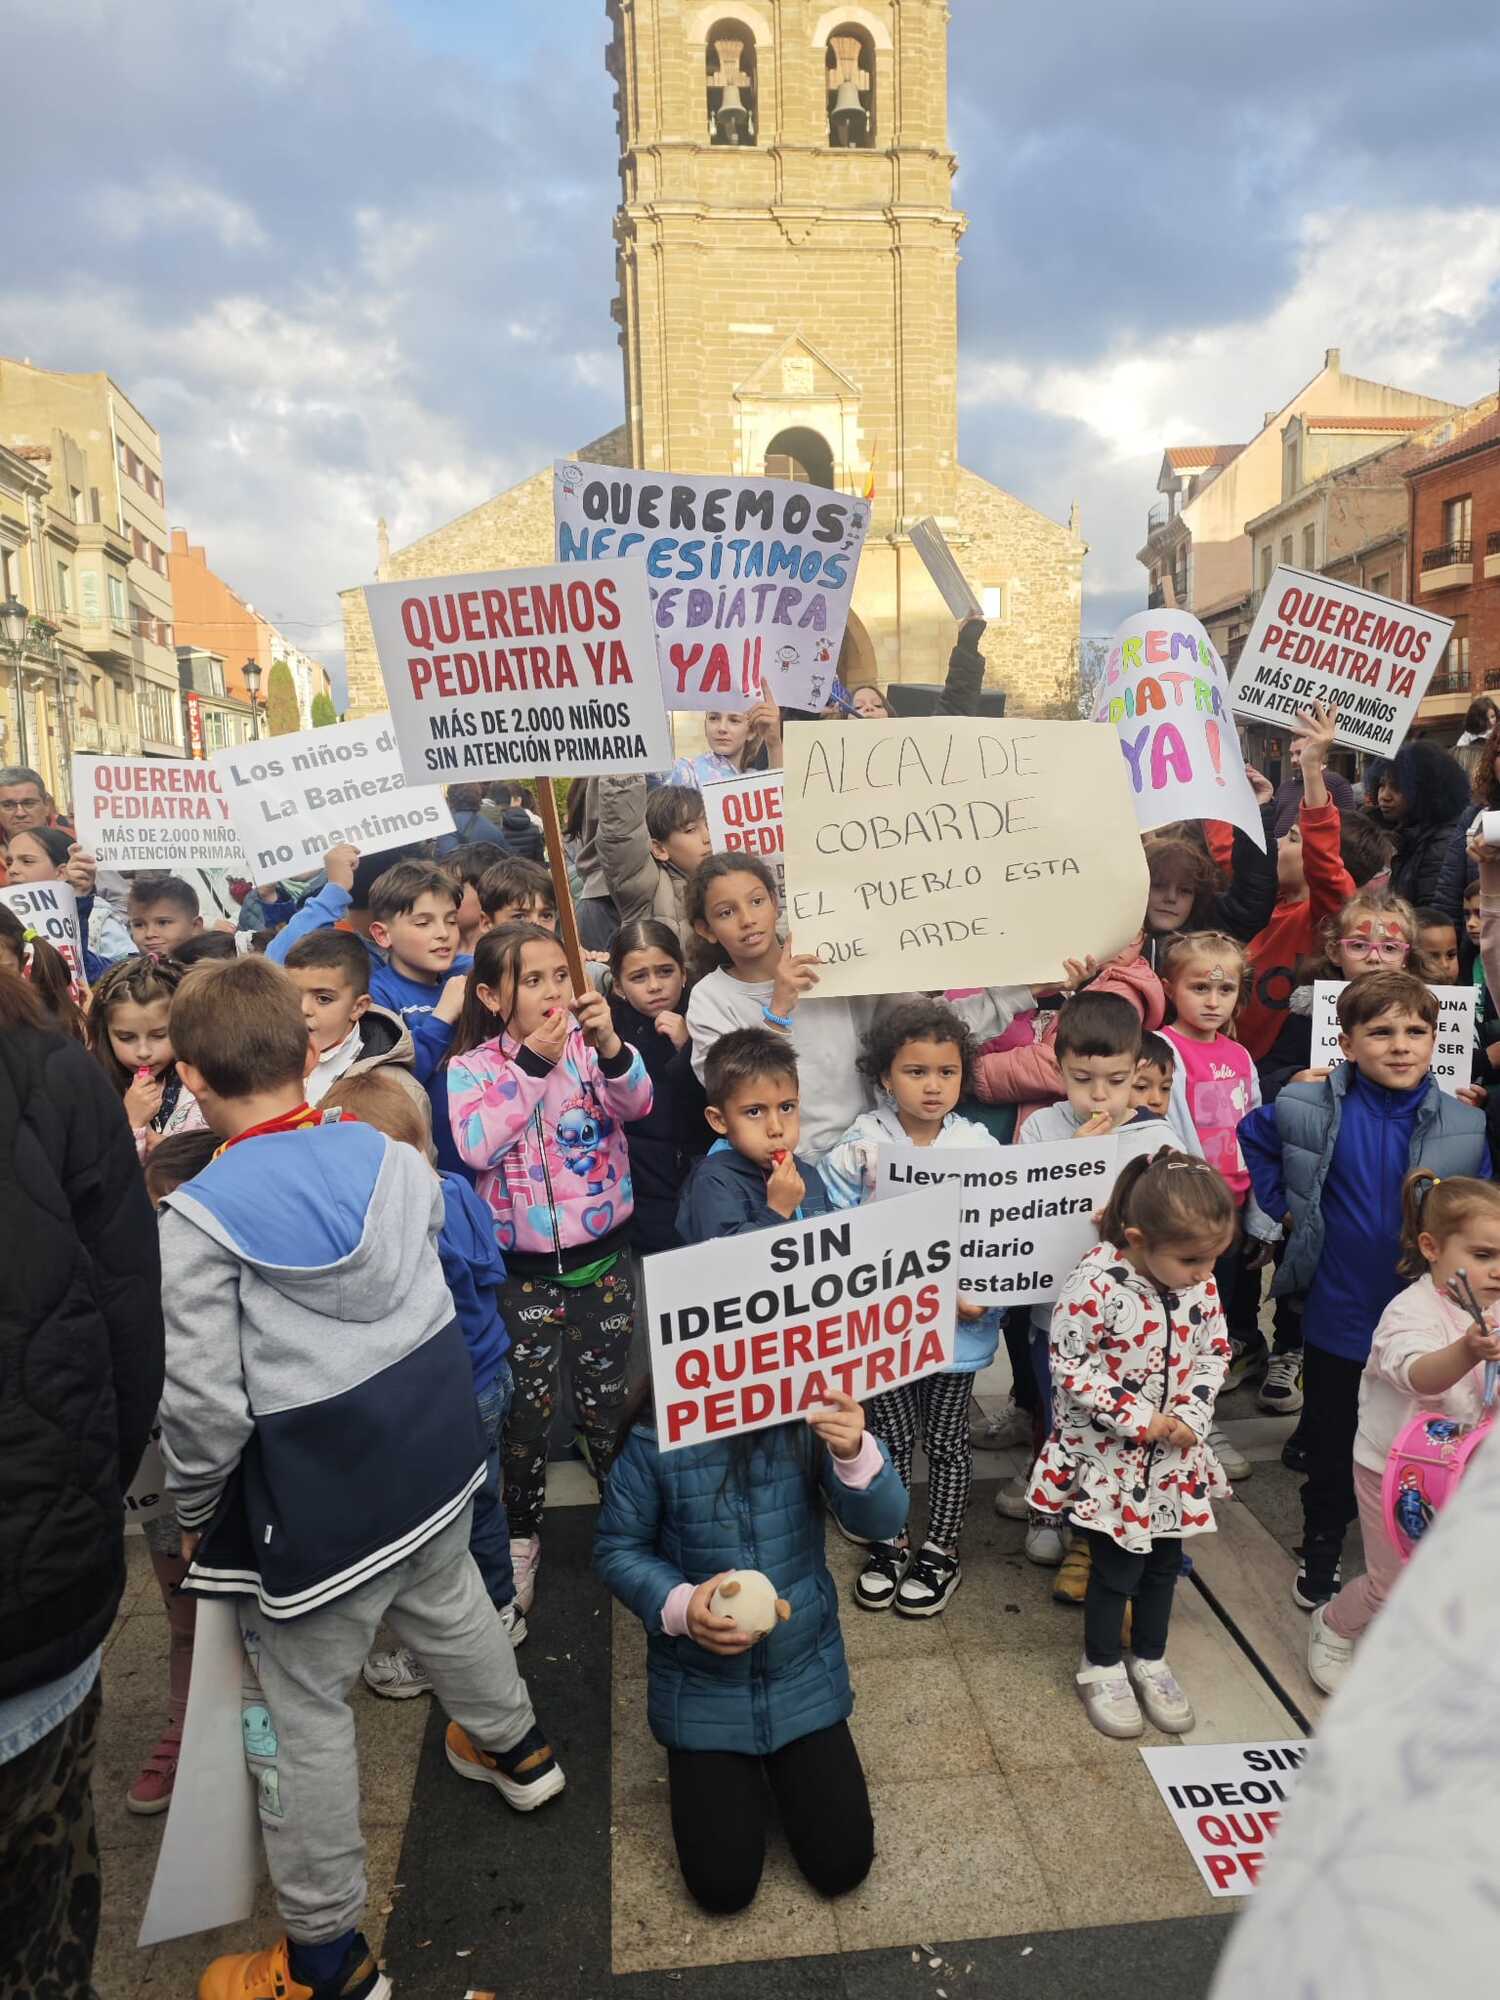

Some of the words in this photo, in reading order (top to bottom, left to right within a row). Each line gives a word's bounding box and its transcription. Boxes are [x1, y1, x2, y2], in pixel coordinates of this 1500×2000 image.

[583, 481, 848, 543] QUEREMOS
[401, 578, 621, 651] QUEREMOS
[1277, 587, 1432, 663] QUEREMOS
[408, 645, 578, 700] PEDIATRA
[582, 640, 633, 686] YA
[1259, 624, 1381, 687] PEDIATRA
[1386, 665, 1418, 698] YA
[1238, 685, 1263, 706] SIN
[1335, 713, 1394, 745] PRIMARIA
[1254, 663, 1291, 692] MÁS
[1292, 676, 1315, 698] DE
[1316, 683, 1354, 710] 2.000
[1355, 696, 1397, 723] NIÑOS
[429, 708, 477, 740] MÁS
[482, 709, 509, 735] DE
[511, 706, 565, 733] 2.000
[569, 699, 631, 730] NIÑOS
[230, 760, 284, 787] Los
[292, 741, 368, 771] niños
[424, 746, 458, 771] SIN
[464, 735, 551, 768] ATENCIÓN
[555, 734, 648, 763] PRIMARIA
[802, 734, 1041, 799] ALCALDE
[93, 796, 212, 820] PEDIATRA
[260, 799, 300, 822] La
[304, 772, 407, 810] Bañeza
[102, 825, 135, 843] MÁS
[139, 829, 157, 842] DE
[160, 828, 200, 843] 2.000
[257, 845, 294, 869] no
[301, 805, 440, 855] mentimos
[815, 796, 1041, 854] COBARDE
[96, 847, 118, 862] SIN
[122, 844, 186, 860] ATENCIÓN
[9, 889, 59, 916] SIN
[793, 890, 835, 920] EL
[854, 865, 982, 911] PUEBLO
[1005, 857, 1081, 883] ESTA
[815, 938, 868, 965] QUE
[899, 917, 1006, 952] ARDE.
[1439, 1001, 1468, 1012] UNA
[1451, 1023, 1460, 1033] A
[1438, 1044, 1464, 1055] SER
[1026, 1160, 1107, 1184] meses
[990, 1197, 1093, 1227] pediatra
[769, 1222, 852, 1274] SIN
[960, 1238, 1035, 1259] diario
[659, 1239, 953, 1346] IDEOLOGÍAS
[959, 1271, 1054, 1293] estable
[675, 1283, 942, 1391] QUEREMOS
[666, 1328, 946, 1443] PEDIATRÍA
